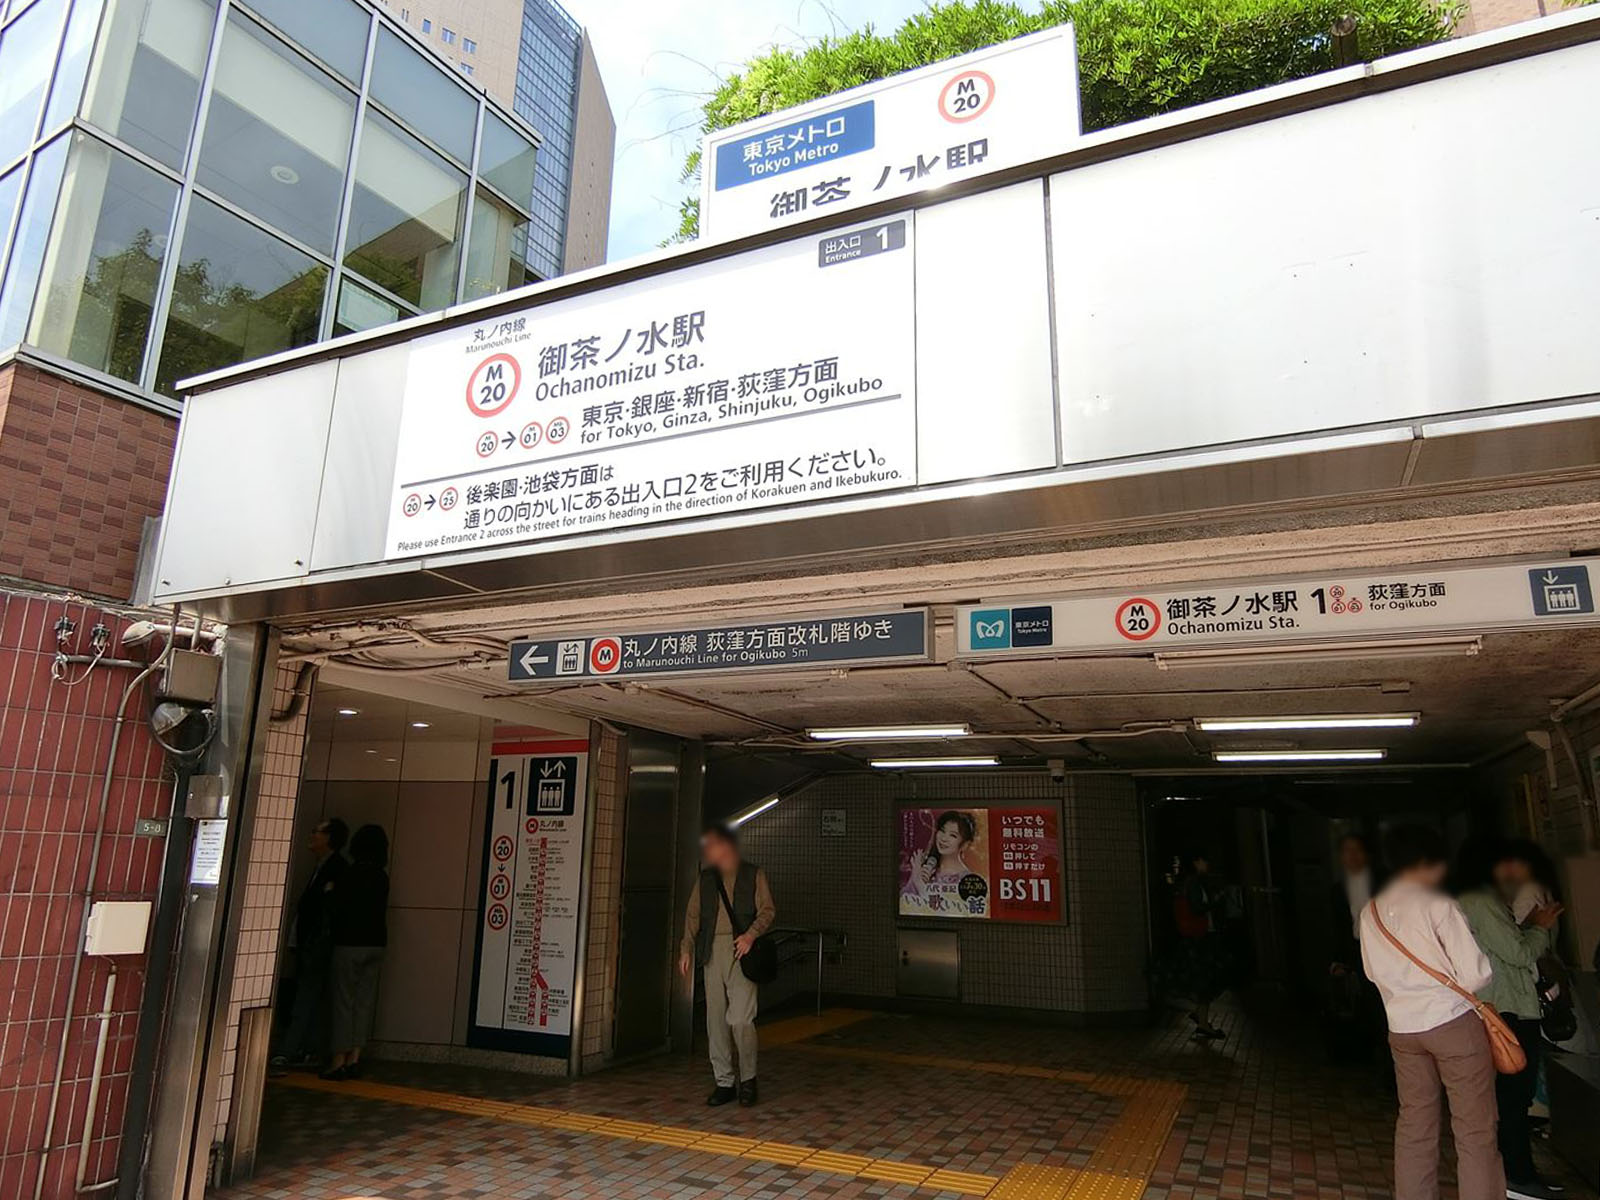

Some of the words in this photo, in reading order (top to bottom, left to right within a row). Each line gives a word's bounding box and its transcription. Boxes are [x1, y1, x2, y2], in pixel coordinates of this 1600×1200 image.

[958, 79, 975, 94] M
[953, 94, 981, 113] 20
[743, 117, 846, 161] 東京メトロ
[749, 154, 791, 177] Tokyo
[795, 141, 838, 167] Metro
[825, 235, 861, 254] 出入口
[876, 226, 888, 250] 1
[825, 250, 861, 264] Entrance
[473, 317, 527, 343] 丸ノ内線
[465, 335, 513, 354] Marunouchi
[515, 332, 532, 343] Line
[538, 311, 705, 379] 御茶ノ水駅
[485, 364, 503, 382] M
[535, 362, 656, 402] Ochanomizu
[664, 353, 704, 375] Sta.
[480, 383, 506, 405] 20
[581, 356, 839, 428] 東京・銀座・新宿・荻窪方面
[580, 430, 602, 444] for
[607, 422, 657, 439] Tokyo,
[662, 409, 712, 429] Ginza,
[718, 394, 798, 418] Shinjuku,
[804, 377, 883, 404] Ogikubo
[524, 432, 537, 444] 01
[550, 427, 565, 439] 03
[480, 441, 494, 452] 20
[463, 448, 886, 530] 通りの向かいにある出入口2をご利用ください。
[466, 463, 614, 506] 後楽園・池袋方面は
[398, 539, 422, 552] Please
[425, 538, 439, 548] use
[441, 531, 478, 545] Entrance
[480, 529, 485, 539] 2
[487, 527, 514, 539] across
[516, 523, 531, 535] the
[533, 518, 560, 532] street
[562, 515, 576, 527] for
[579, 511, 607, 524] trains
[609, 505, 650, 521] heading
[652, 504, 662, 514] in
[666, 499, 682, 512] the
[685, 492, 733, 509] direction
[736, 489, 748, 502] of
[751, 482, 806, 500] Korakuen
[810, 478, 832, 491] and
[836, 468, 902, 487] Ikebukuro.
[406, 502, 418, 512] 20
[443, 496, 454, 506] 25
[1368, 582, 1445, 602] 荻窪方面
[1130, 605, 1145, 617] M
[1167, 590, 1297, 620] 御茶ノ水駅
[1310, 588, 1326, 614] 1
[1370, 602, 1385, 611] for
[1389, 598, 1437, 612] Ogikubo
[1015, 620, 1049, 629] 東京メトロ
[1127, 618, 1149, 632] 20
[1168, 617, 1263, 635] Ochanomizu
[1269, 614, 1300, 630] Sta.
[624, 634, 697, 657] 丸ノ内線
[707, 619, 892, 652] 荻窪方面改札階ゆき
[600, 649, 611, 661] M
[623, 660, 634, 669] to
[636, 655, 695, 668] Marunouchi
[698, 652, 719, 664] Line
[722, 652, 737, 662] for
[740, 649, 786, 662] Ogikubo
[792, 648, 809, 658] 5m
[500, 771, 515, 809] 1
[1002, 815, 1045, 826] いつでも
[497, 846, 509, 856] 20
[1003, 843, 1039, 851] リモコンの
[494, 884, 505, 894] 01
[1000, 878, 1051, 902] BS11
[491, 914, 503, 924] 03
